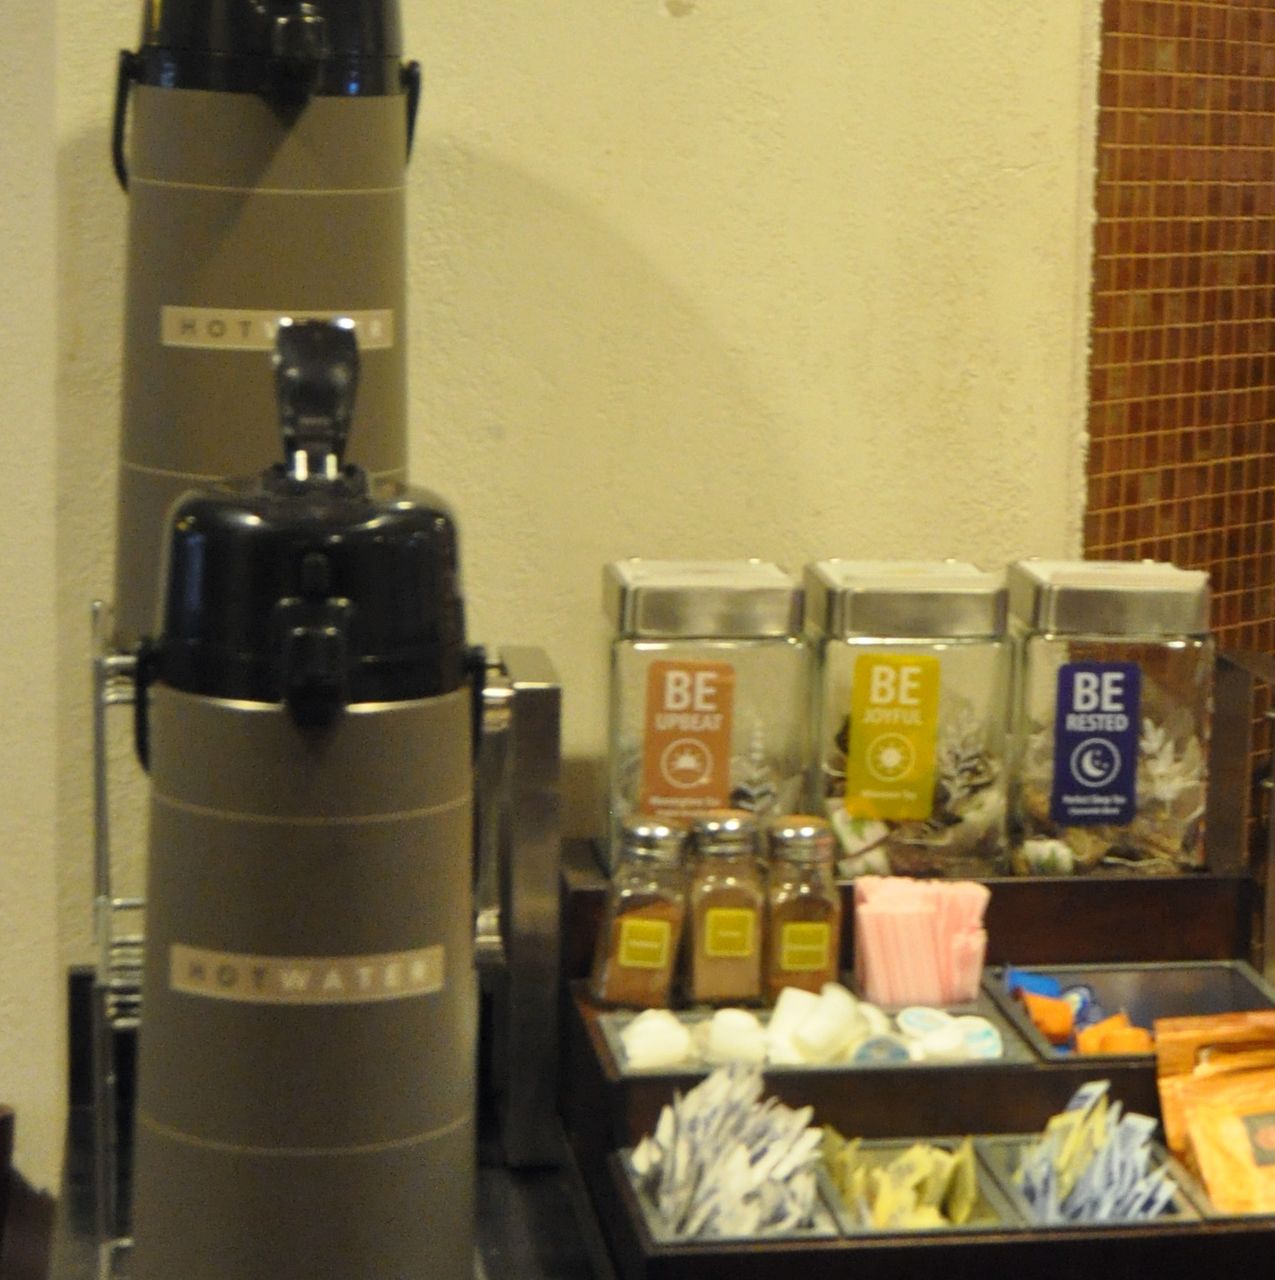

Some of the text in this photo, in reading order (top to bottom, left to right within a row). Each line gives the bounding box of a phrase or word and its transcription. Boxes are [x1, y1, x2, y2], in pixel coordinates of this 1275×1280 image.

[665, 670, 719, 711] BE
[869, 664, 922, 706] BE
[1072, 671, 1126, 712] BE
[1065, 713, 1130, 732] RESTED
